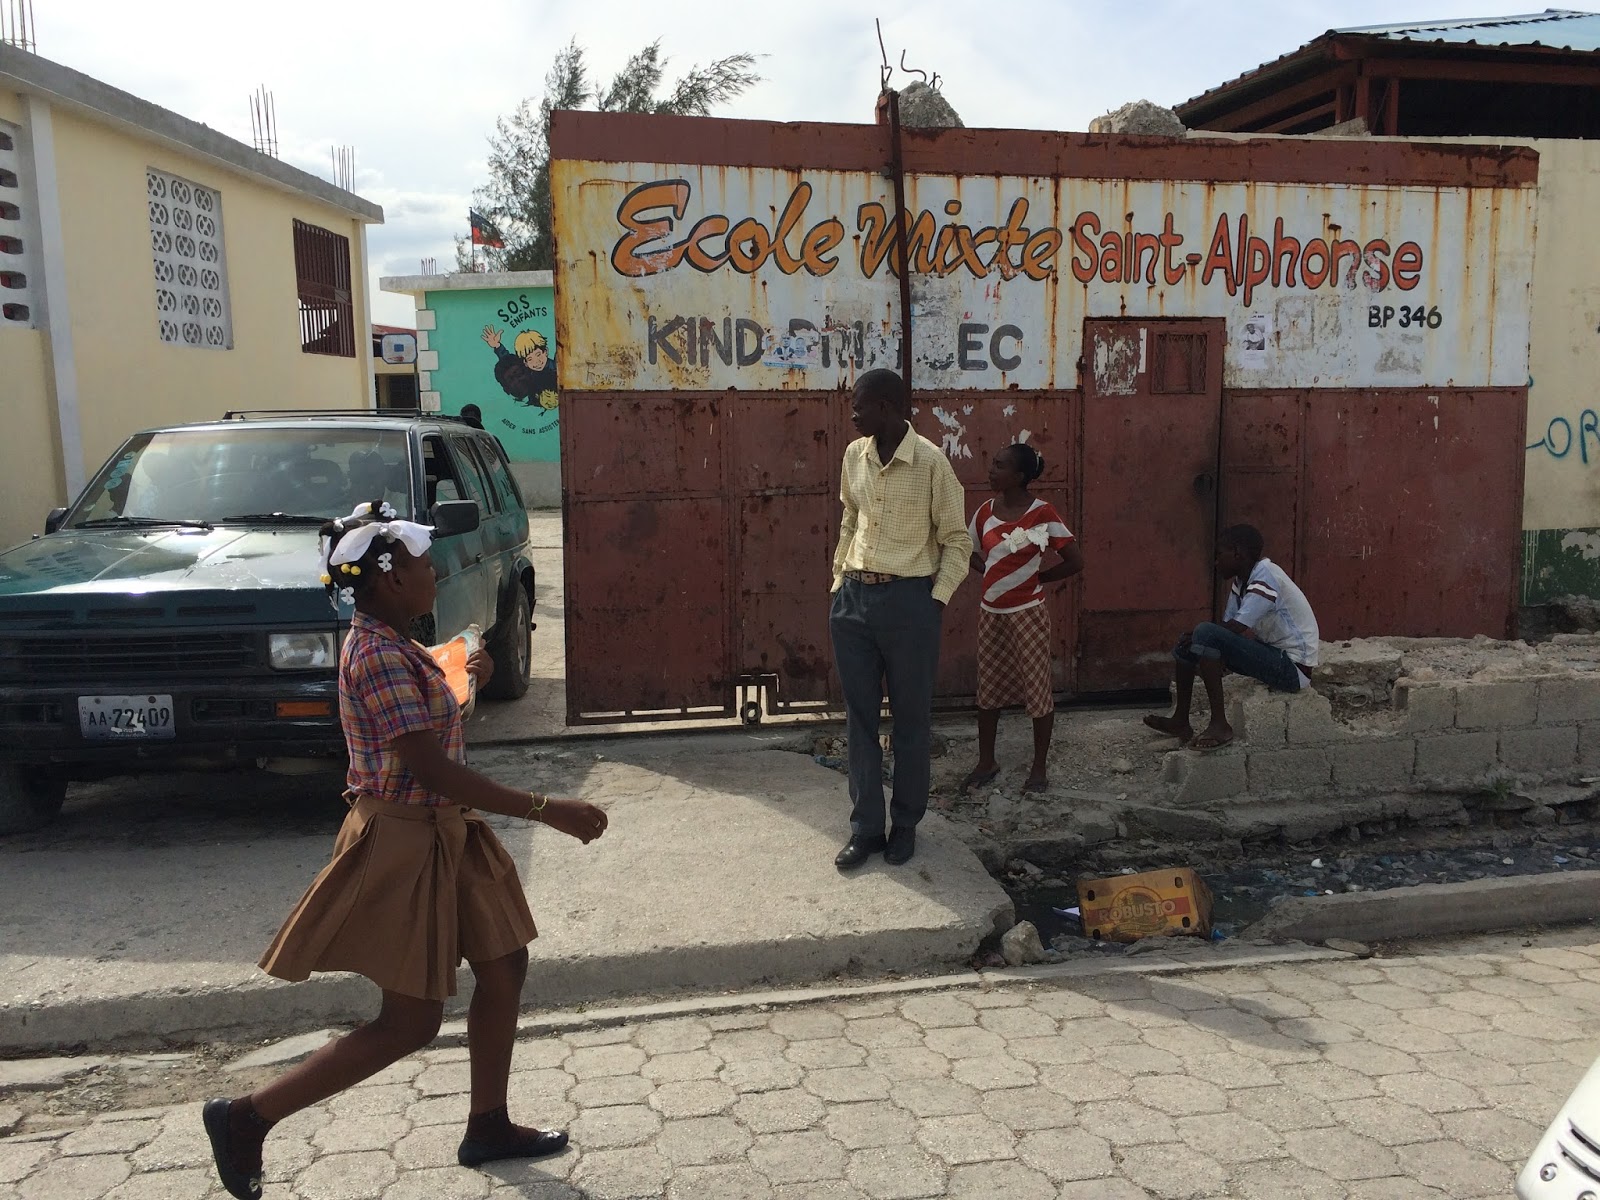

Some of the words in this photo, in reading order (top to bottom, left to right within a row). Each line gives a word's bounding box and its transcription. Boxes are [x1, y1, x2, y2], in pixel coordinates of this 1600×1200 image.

[610, 178, 845, 277] Ecole
[1071, 210, 1424, 307] Saint-Alphonse
[509, 307, 548, 328] ENFANTS
[1398, 305, 1443, 330] 346
[647, 315, 766, 367] KIND
[501, 418, 517, 430] AIDER
[521, 427, 536, 435] SANS
[1098, 899, 1176, 922] ROBUSTO
